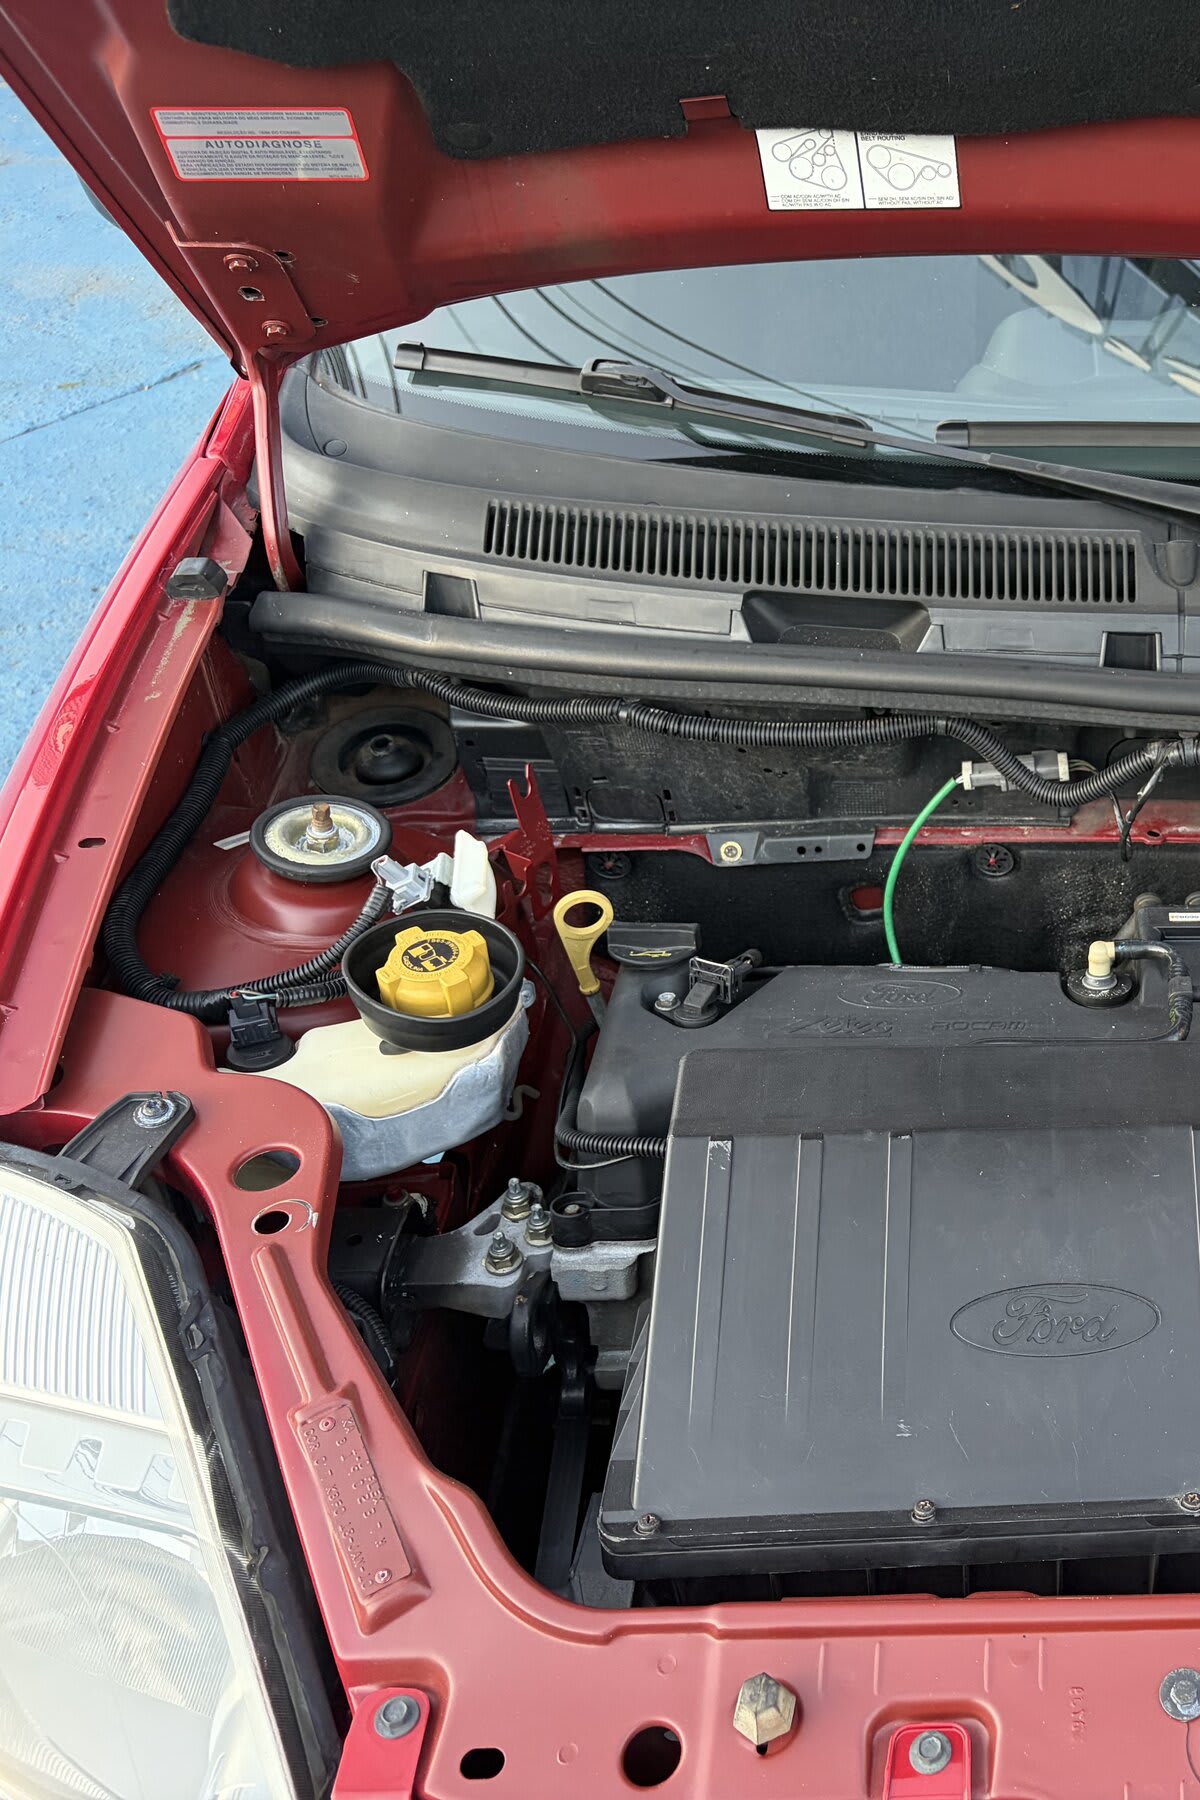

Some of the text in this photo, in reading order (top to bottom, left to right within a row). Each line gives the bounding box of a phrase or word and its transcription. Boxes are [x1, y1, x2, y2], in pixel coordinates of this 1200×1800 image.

[206, 140, 322, 149] AUTODIAGNOSE
[863, 982, 938, 1004] Ford
[993, 1291, 1120, 1346] Ford
